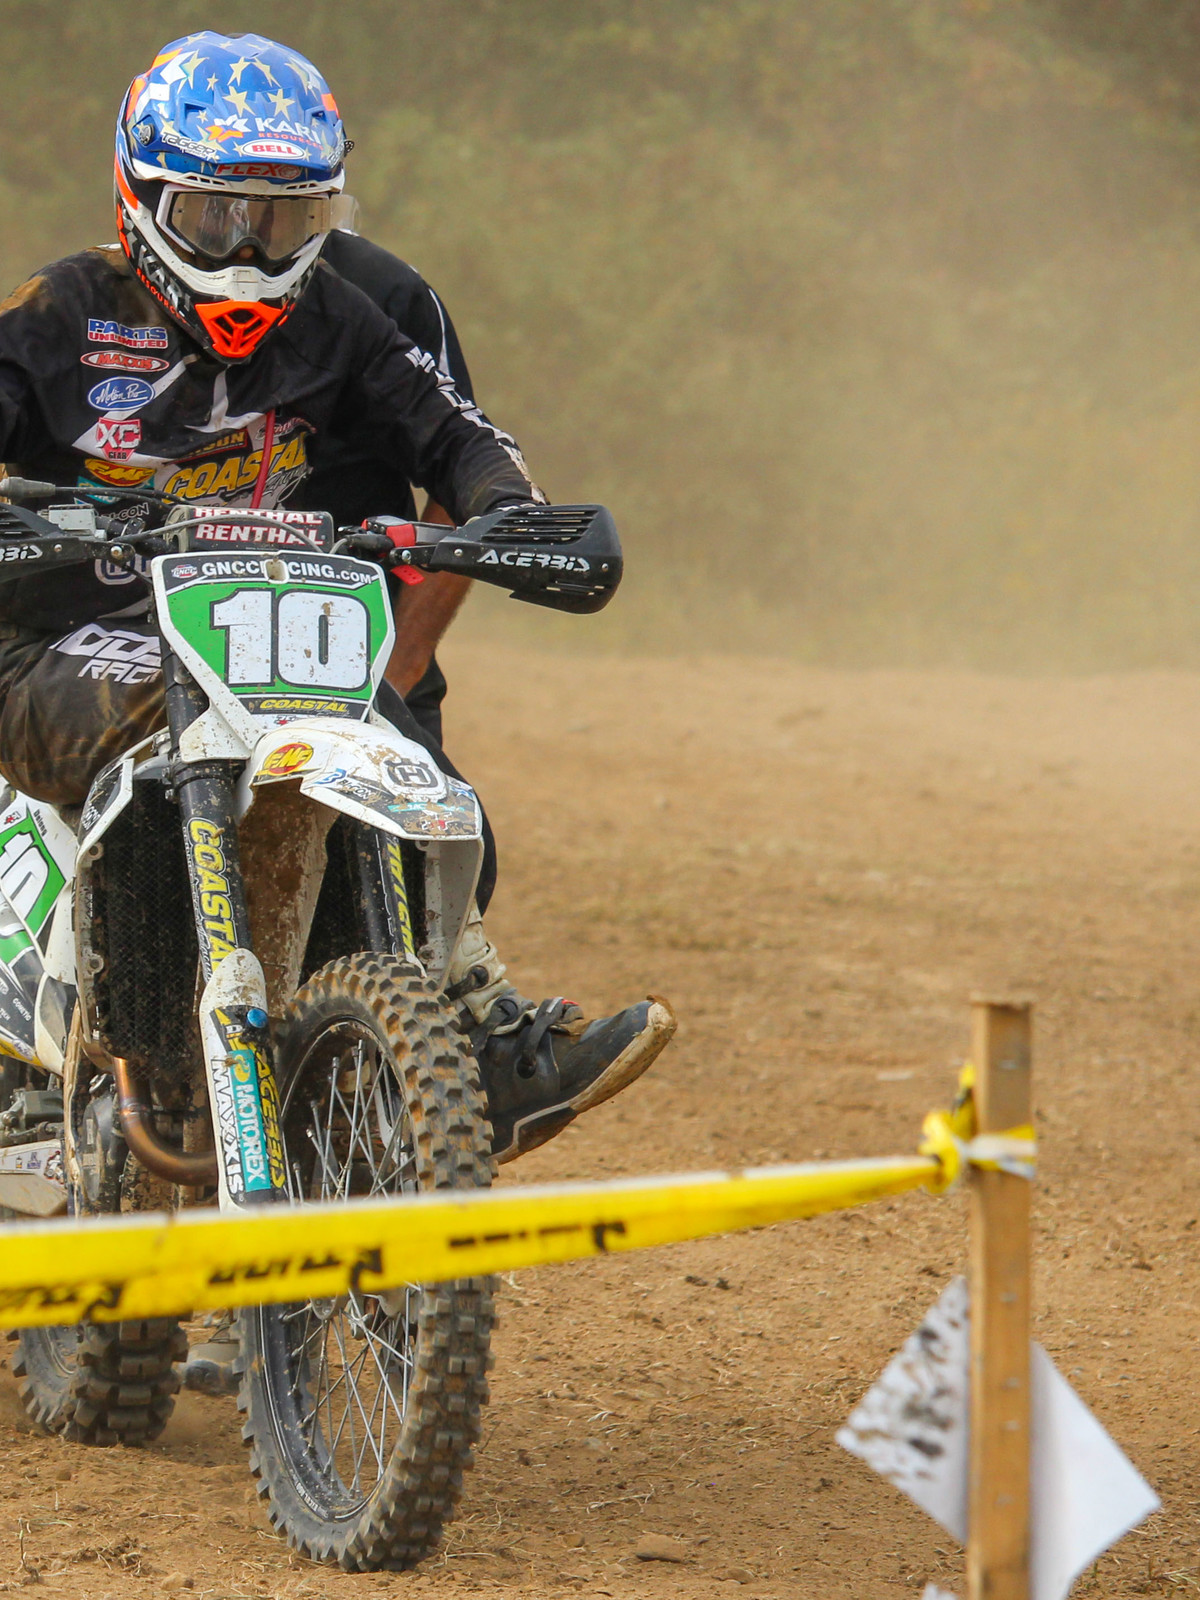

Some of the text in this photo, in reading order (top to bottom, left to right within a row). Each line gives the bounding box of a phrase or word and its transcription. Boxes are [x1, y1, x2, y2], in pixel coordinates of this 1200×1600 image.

[251, 144, 297, 155] BELL
[215, 162, 280, 177] FLEX
[87, 318, 167, 340] PARTS
[87, 331, 168, 349] UNLIMITED
[96, 353, 154, 370] MAXXIS
[95, 422, 141, 449] XC
[108, 451, 128, 460] GEAR
[163, 430, 307, 504] COASTAL
[195, 523, 325, 546] RENTHAL
[476, 549, 591, 573] ACERBIS
[201, 560, 373, 585] GNCCCING.COM
[212, 588, 370, 691] 10
[260, 699, 348, 713] COASTAL
[264, 747, 313, 769] FMF
[211, 1057, 245, 1195] MAXXIS
[234, 1083, 267, 1185] MOTOREX
